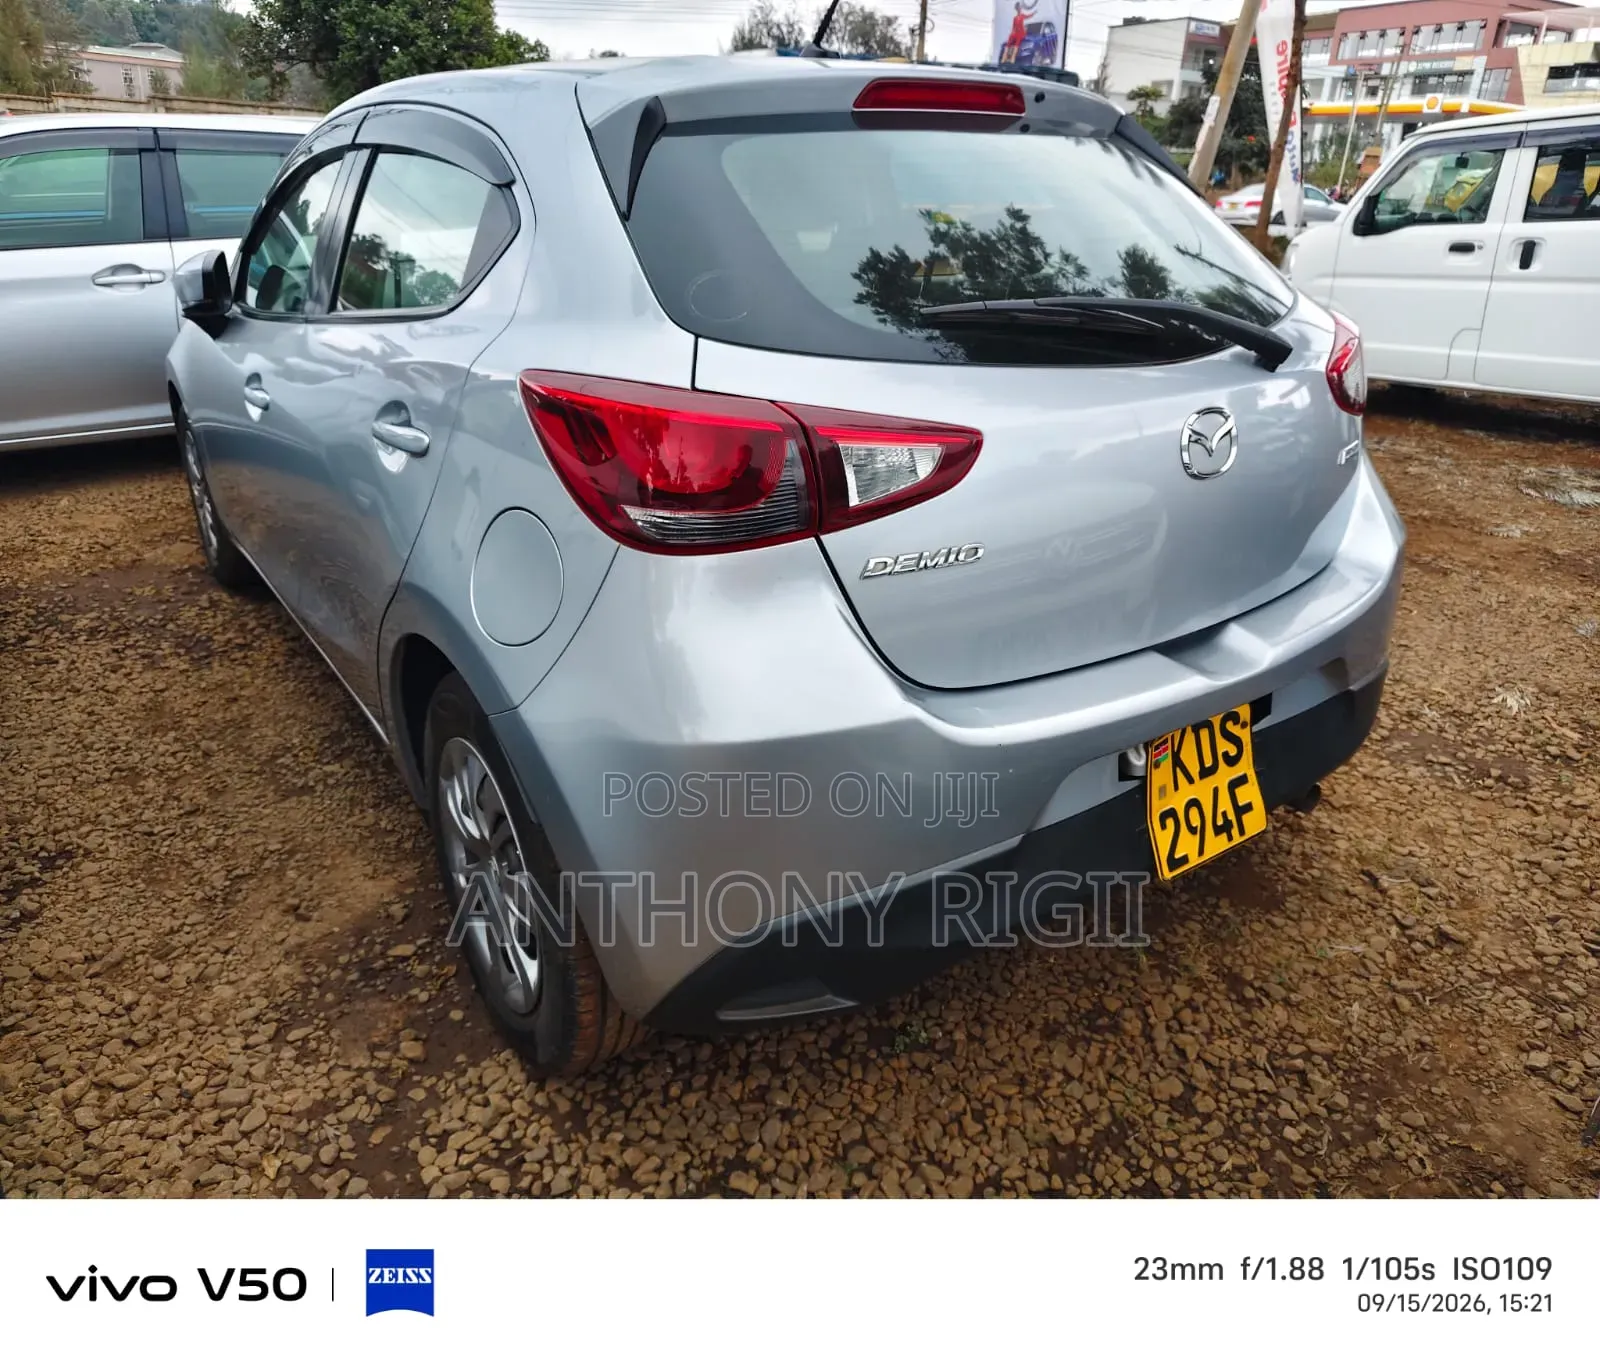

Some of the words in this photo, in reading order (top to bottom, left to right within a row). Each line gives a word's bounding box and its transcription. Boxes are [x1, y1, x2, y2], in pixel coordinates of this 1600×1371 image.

[860, 542, 985, 580] DEMIO
[1170, 710, 1244, 792] KDS
[1158, 773, 1254, 872] 294F
